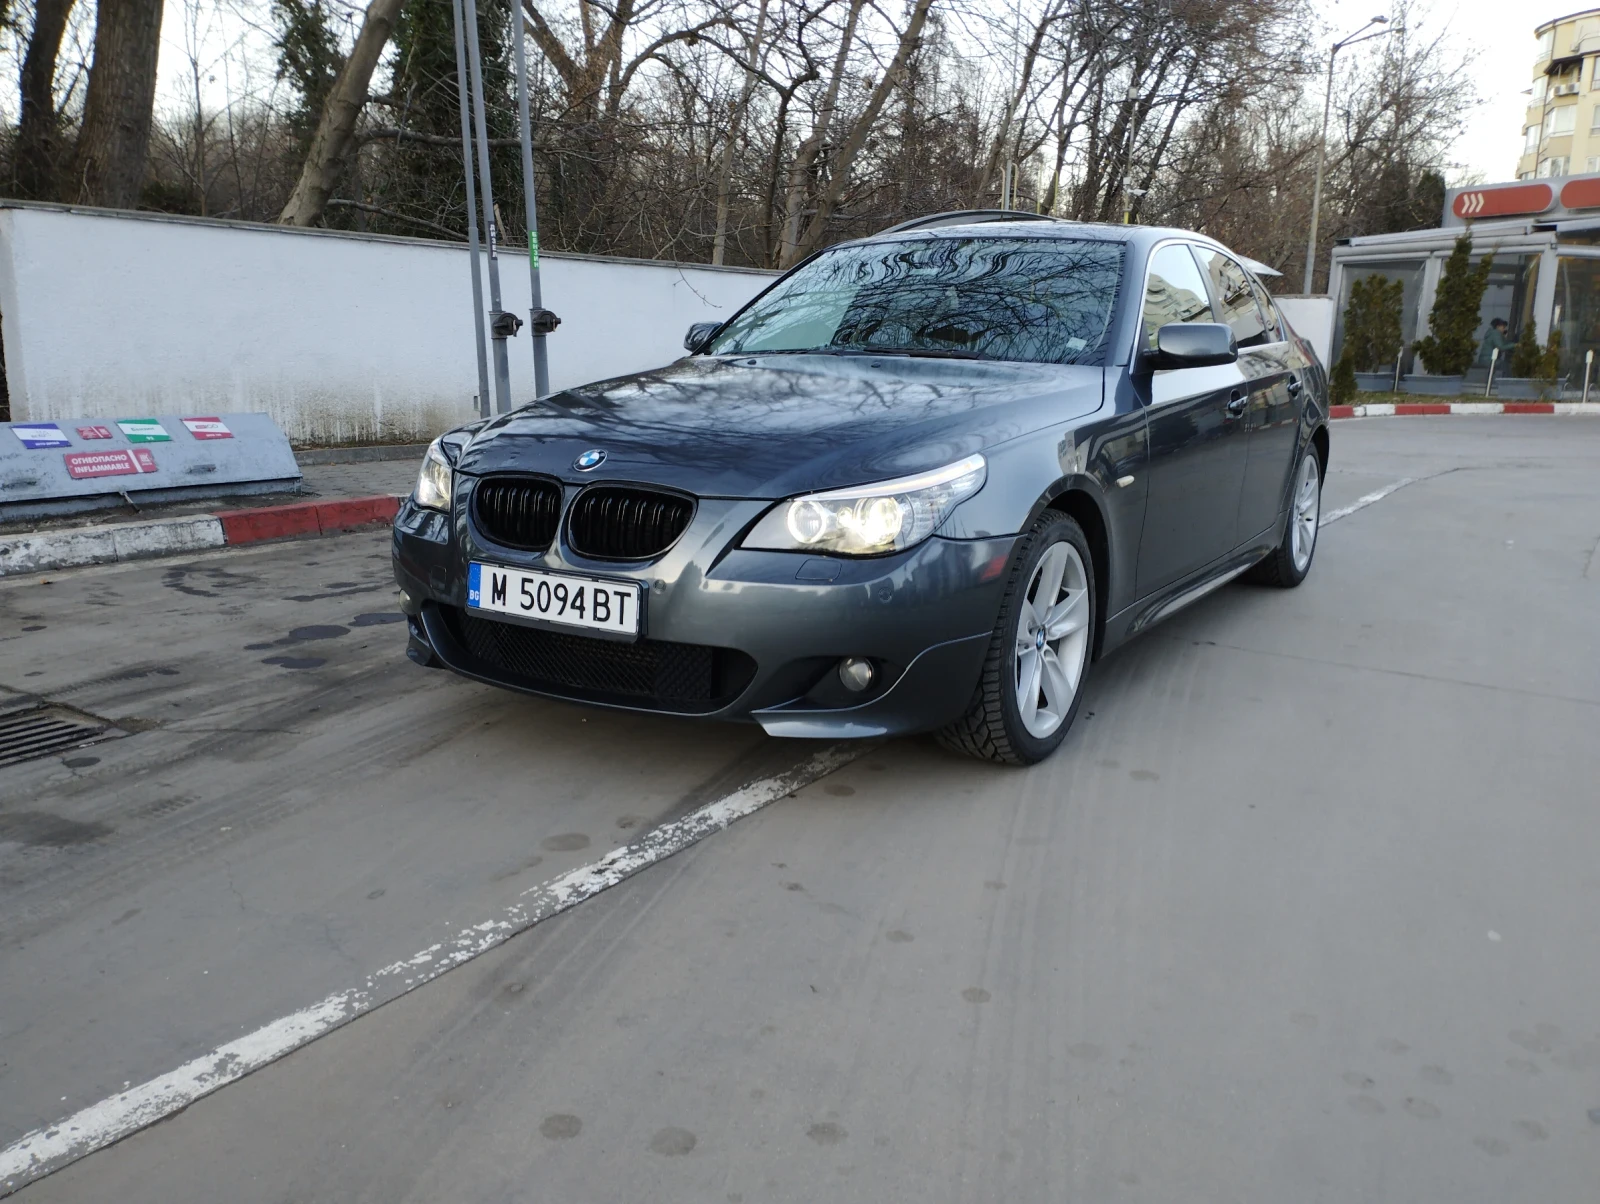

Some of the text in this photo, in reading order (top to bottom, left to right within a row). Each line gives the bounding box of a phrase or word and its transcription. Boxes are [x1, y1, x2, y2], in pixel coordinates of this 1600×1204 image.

[71, 454, 128, 465] ОГНЕОПАСНО
[74, 462, 131, 474] INFLAMMABLE
[469, 589, 480, 601] BG
[491, 572, 507, 607] M
